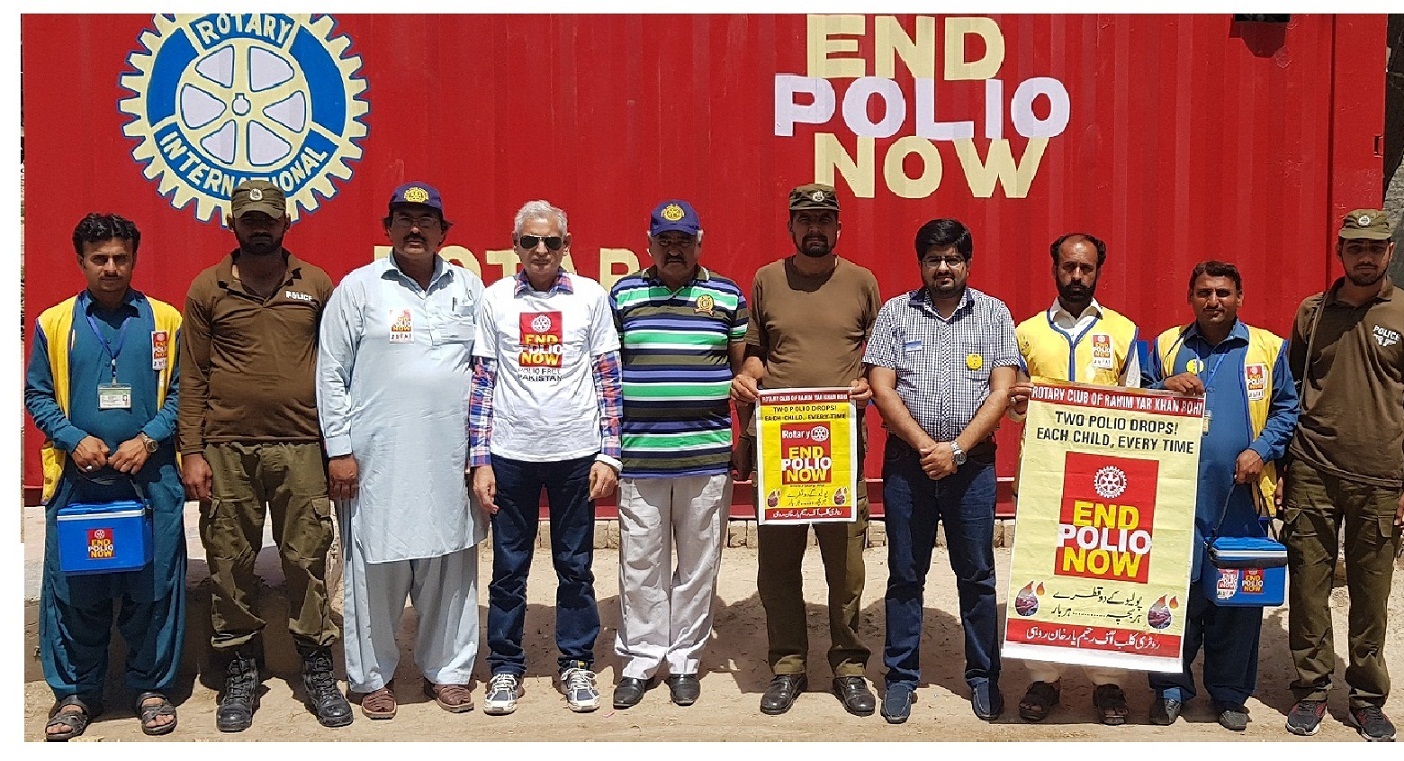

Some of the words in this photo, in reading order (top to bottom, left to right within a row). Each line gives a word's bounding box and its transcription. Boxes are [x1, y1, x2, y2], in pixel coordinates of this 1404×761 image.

[196, 14, 293, 45] ROTARY
[806, 14, 1006, 80] END
[774, 73, 1070, 140] POLIO
[159, 131, 329, 197] INTERNIONAL
[814, 133, 1050, 198] NOW
[524, 334, 559, 345] END
[522, 352, 559, 366] NOW
[1032, 386, 1065, 400] ROTARY
[1068, 389, 1088, 404] CLUB
[1091, 393, 1104, 406] OF
[1105, 395, 1133, 408] RAHIM
[1136, 396, 1153, 410] YAR
[1155, 398, 1179, 412] KHAN
[782, 430, 810, 440] Rotary
[1055, 410, 1084, 426] TWO
[1088, 415, 1126, 430] POLIO
[1130, 419, 1178, 436] DROPS!
[788, 446, 824, 458] END
[1037, 428, 1068, 441] EACH
[1074, 430, 1114, 448] CHILD,
[1118, 436, 1158, 450] EVERY
[1163, 439, 1194, 454] TIME
[781, 457, 832, 471] POLIO
[786, 469, 826, 482] NOW
[1073, 500, 1139, 530] END
[92, 539, 111, 547] END
[1057, 524, 1152, 555] POLIO
[1063, 546, 1142, 578] NOW
